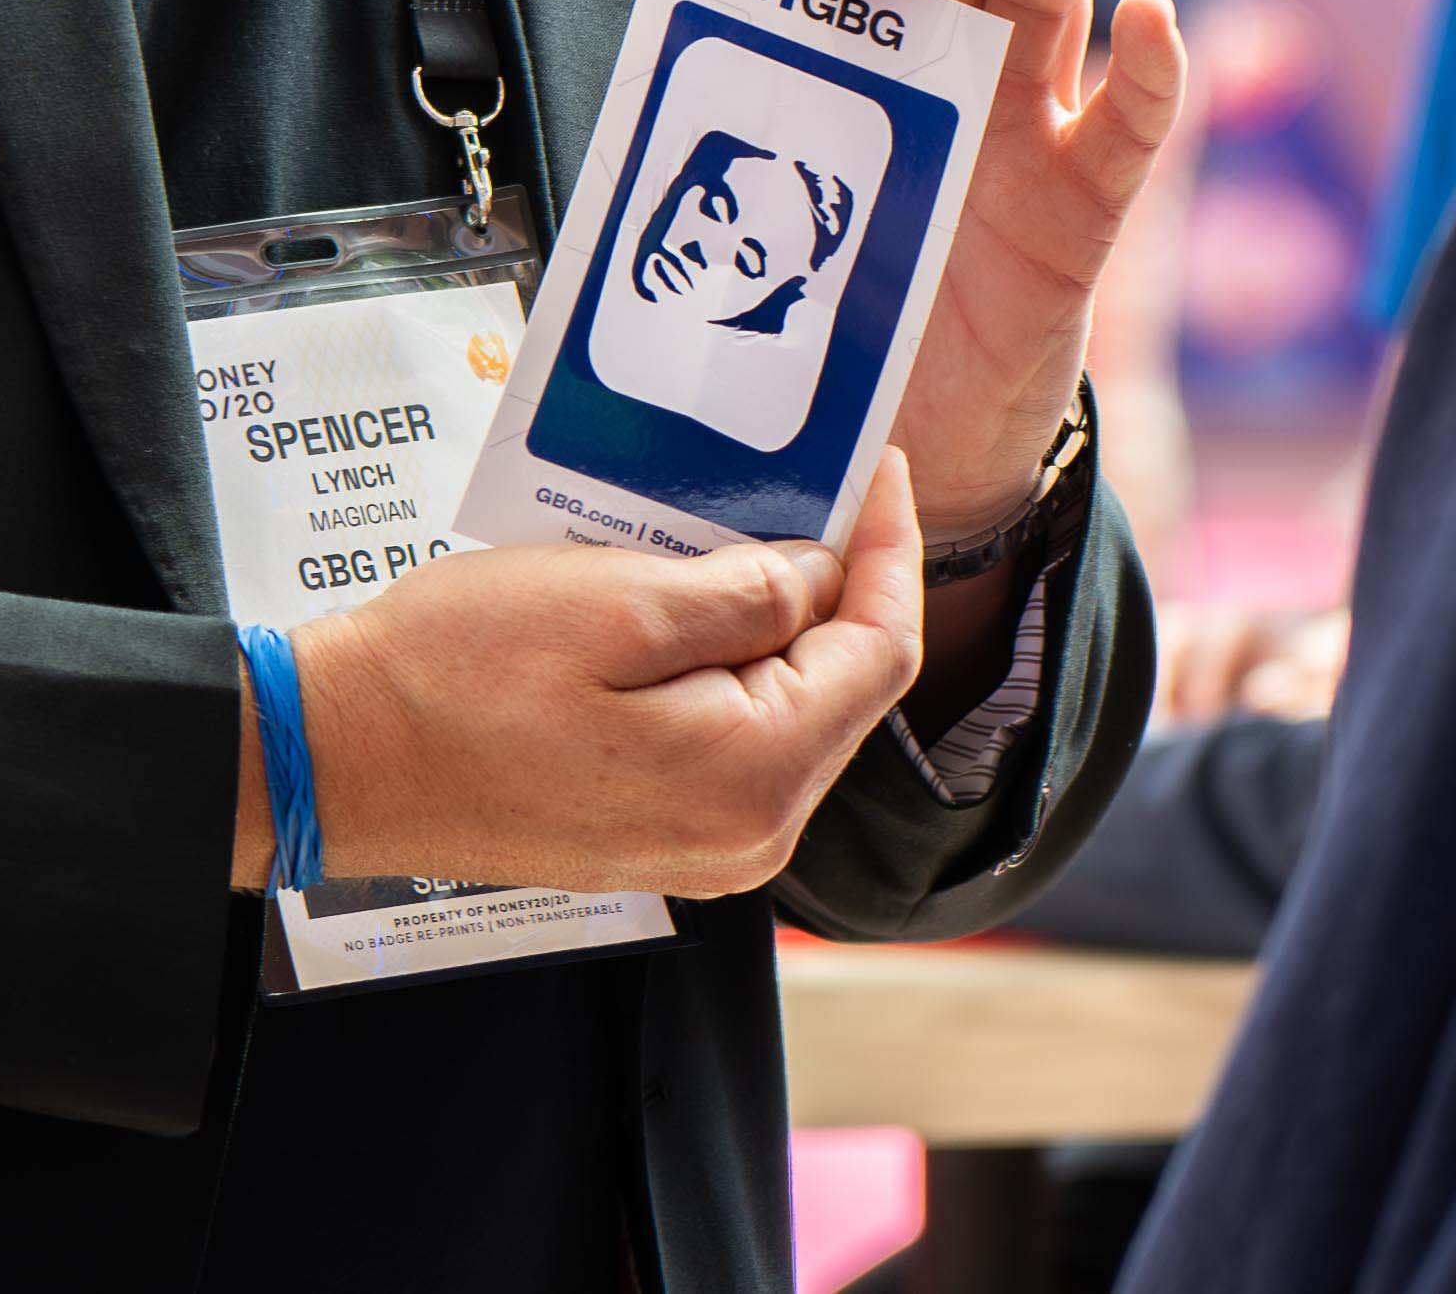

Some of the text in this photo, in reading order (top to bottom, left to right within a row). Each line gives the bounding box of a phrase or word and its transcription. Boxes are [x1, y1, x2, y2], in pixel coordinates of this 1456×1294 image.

[196, 359, 276, 392] ONEY
[199, 391, 275, 422] 0/20
[246, 403, 436, 462] SPENCER
[311, 463, 396, 494] LYNCH
[309, 498, 418, 532] MAGICIAN
[535, 487, 634, 536] GBG.com
[298, 548, 378, 590] GBG
[344, 940, 365, 952] NO
[369, 931, 415, 948] BADGE
[417, 922, 485, 941] RE-PRINTS
[496, 902, 624, 929] NON-TRANSFERABLE
[394, 909, 463, 929] PROPERTY
[467, 906, 484, 917] OF
